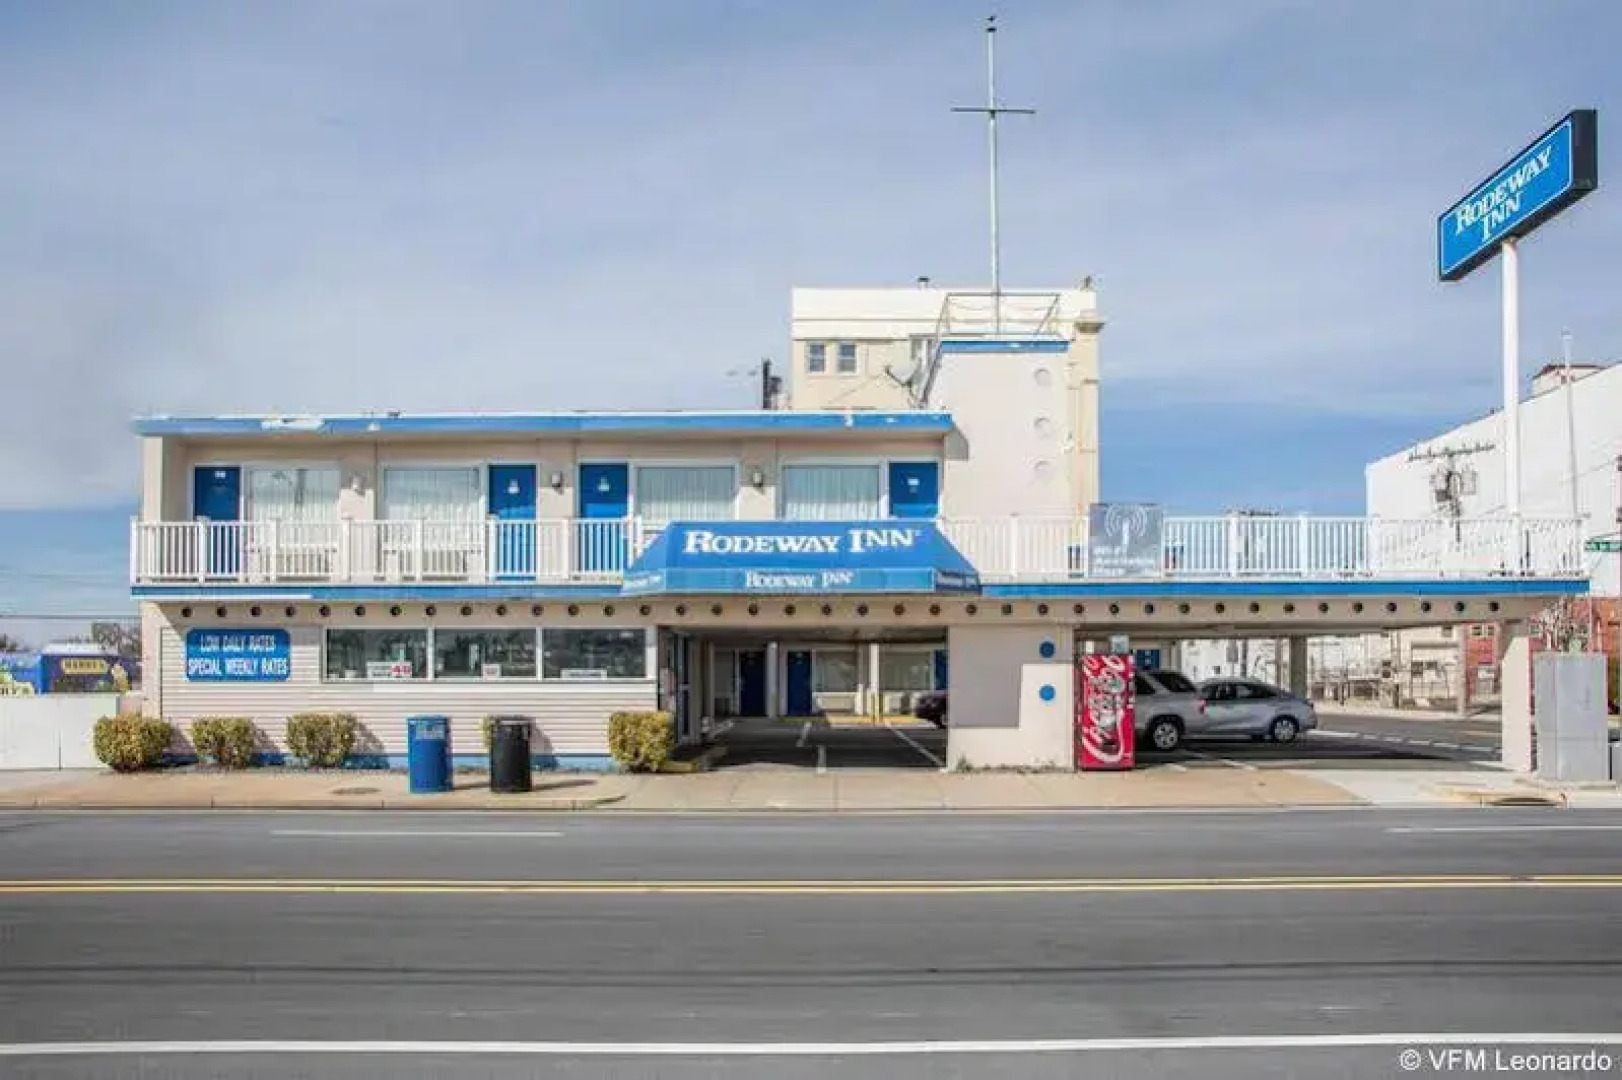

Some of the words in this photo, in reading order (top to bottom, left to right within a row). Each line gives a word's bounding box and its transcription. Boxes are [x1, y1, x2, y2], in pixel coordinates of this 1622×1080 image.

[1454, 146, 1551, 236] RODEWAY
[1481, 191, 1526, 242] INN
[682, 530, 841, 553] RODEWAY
[848, 529, 915, 553] INN
[188, 657, 222, 676] SPECIAL
[224, 657, 259, 676] WEEKLY
